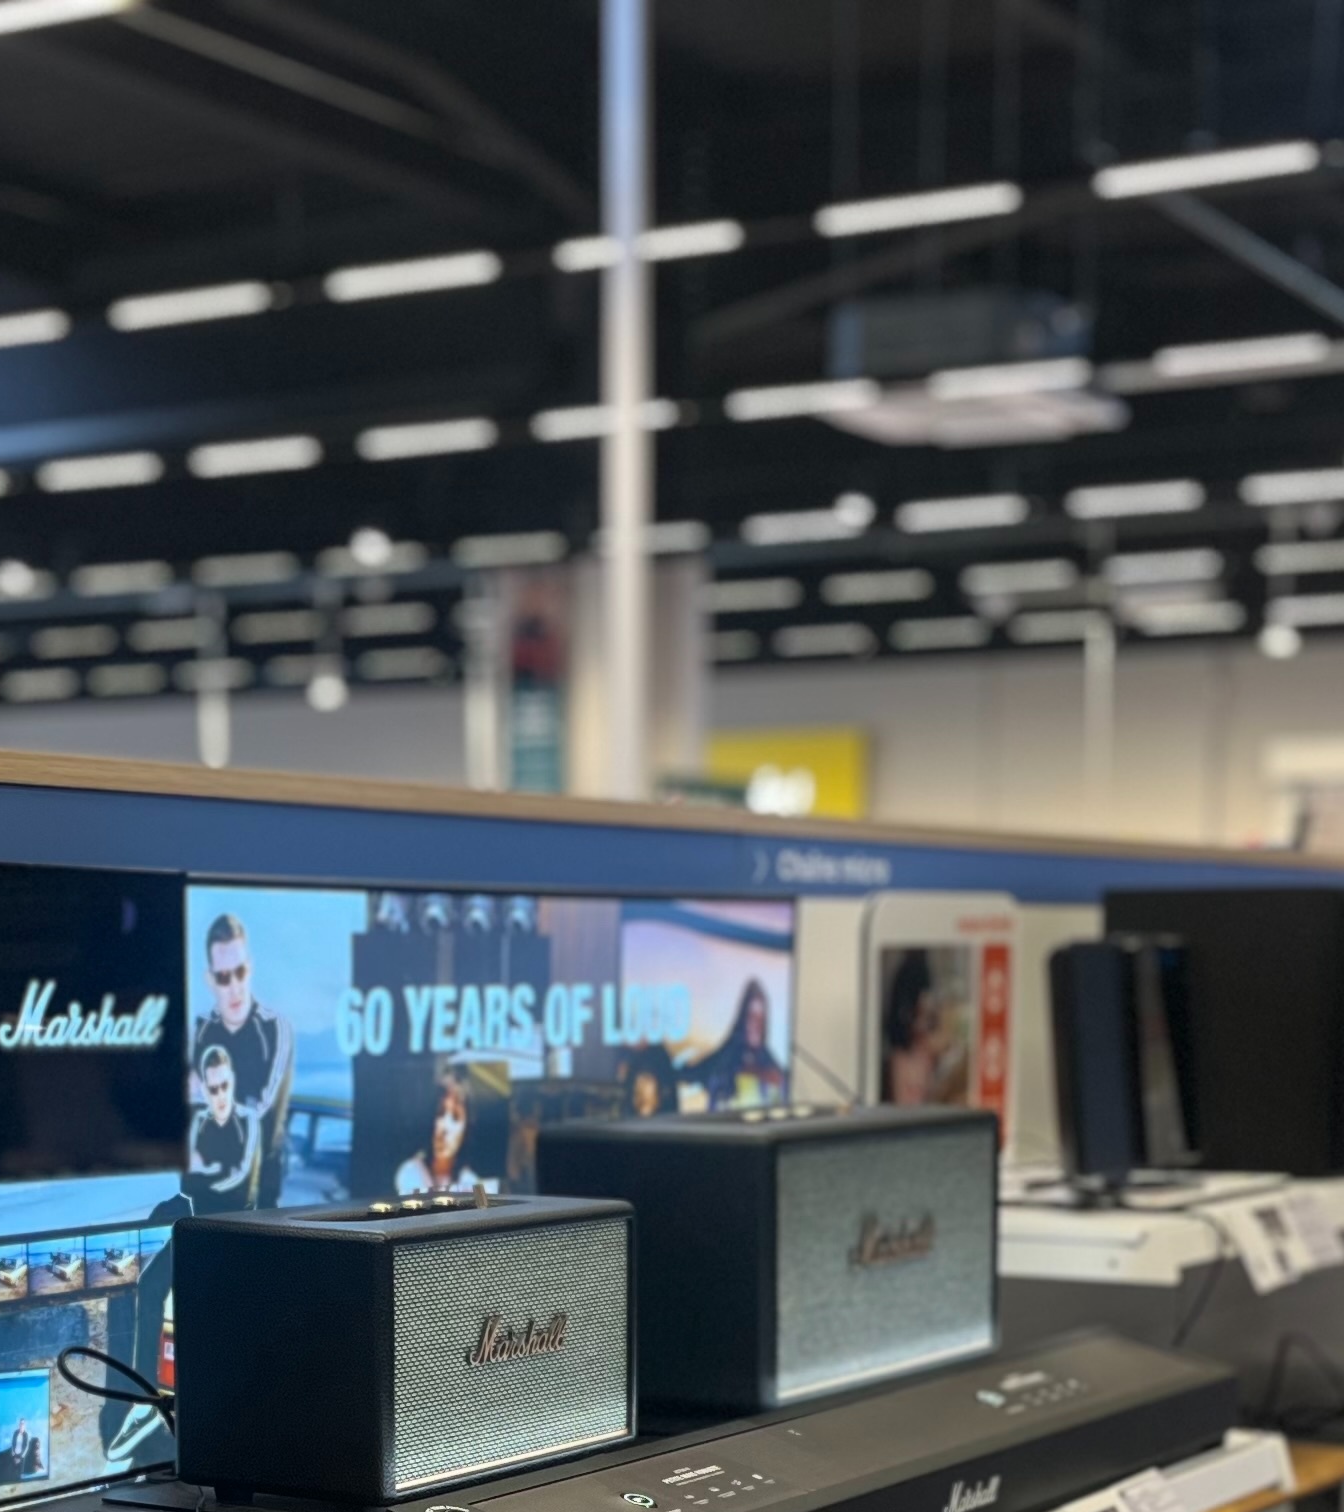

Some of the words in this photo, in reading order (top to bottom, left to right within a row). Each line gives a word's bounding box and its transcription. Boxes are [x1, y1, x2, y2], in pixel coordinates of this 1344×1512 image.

[335, 986, 394, 1055] 60
[403, 983, 536, 1053] YEARS
[545, 982, 594, 1046] OF
[469, 1314, 568, 1366] Marshall
